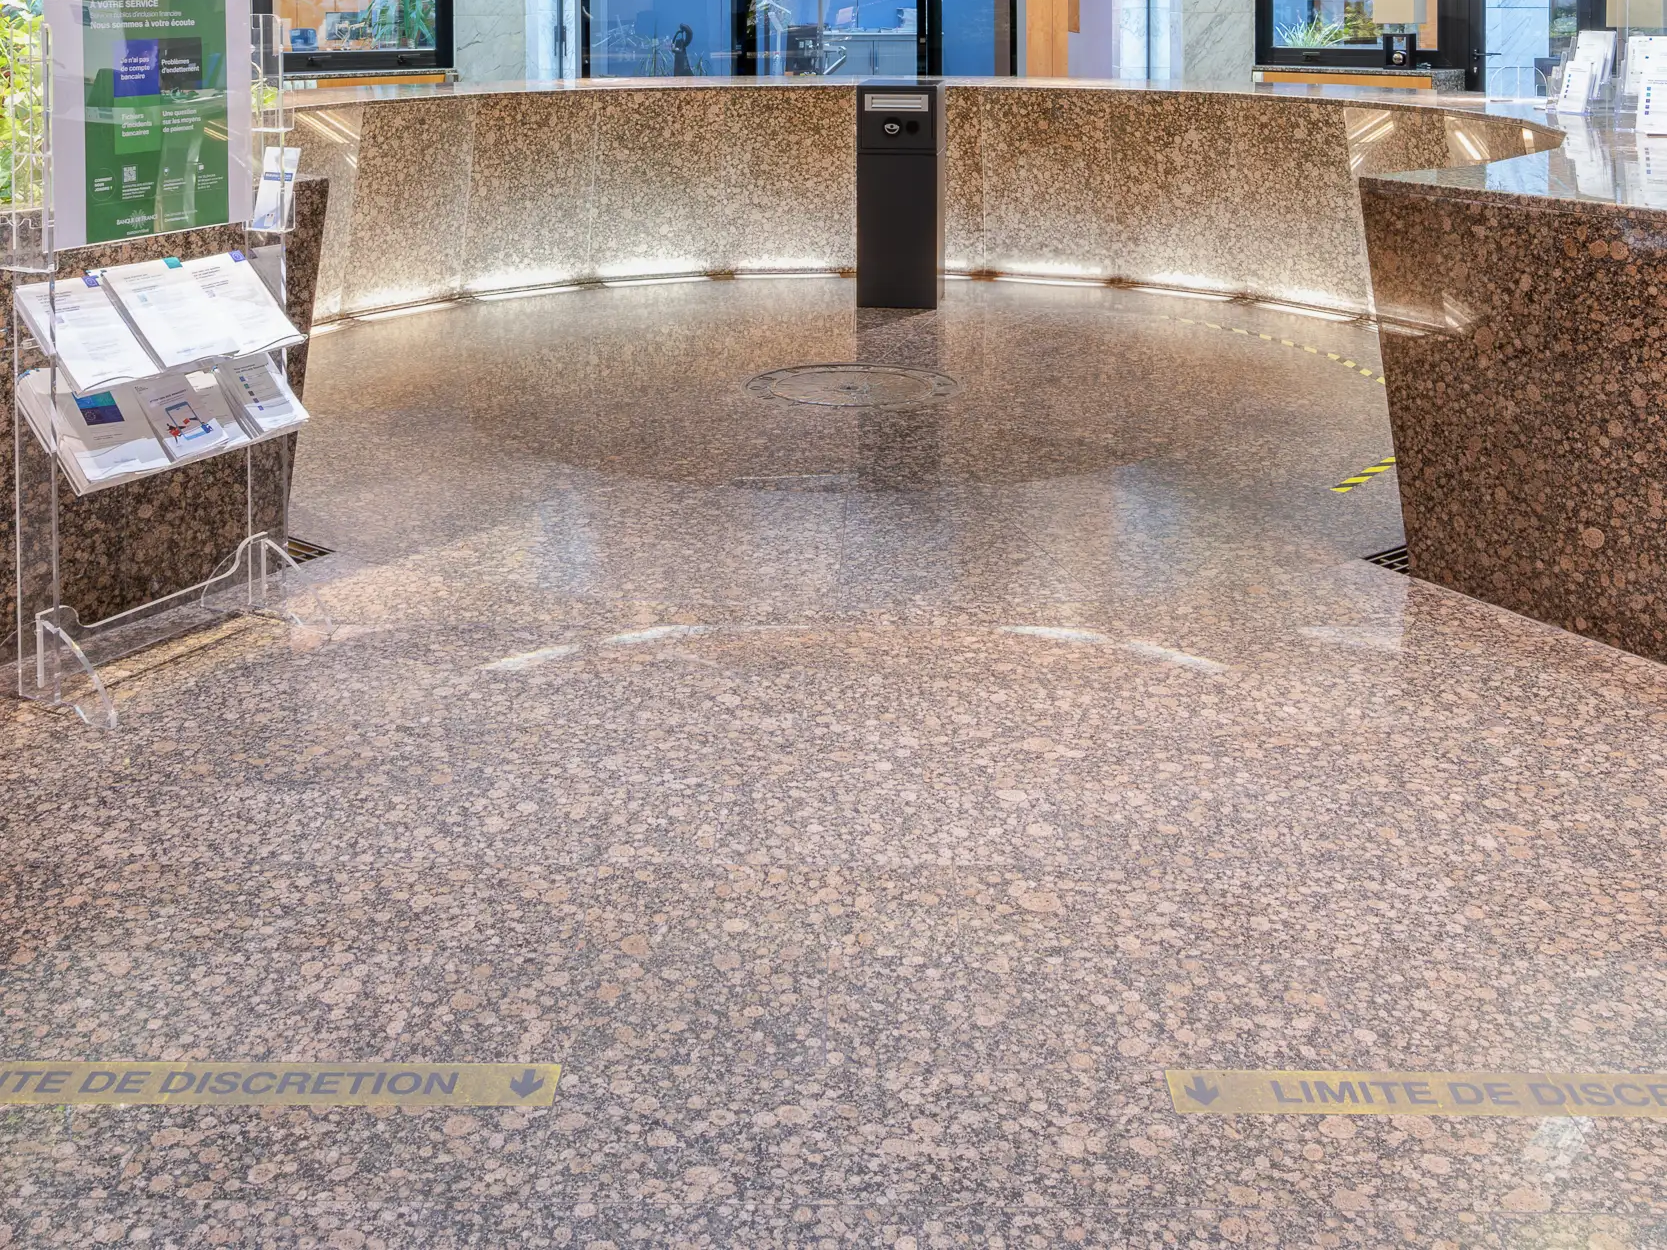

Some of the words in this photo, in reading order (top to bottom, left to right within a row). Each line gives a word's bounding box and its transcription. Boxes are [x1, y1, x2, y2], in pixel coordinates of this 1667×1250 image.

[98, 0, 124, 9] VOTRE
[125, 0, 159, 8] SERVICE
[90, 22, 111, 30] Nous
[111, 20, 143, 29] sommes
[144, 19, 150, 28] à
[151, 19, 170, 28] votre
[170, 18, 196, 27] écoute
[161, 58, 190, 66] Problèmes
[129, 64, 151, 73] compte
[120, 73, 146, 81] bancaire
[78, 1071, 151, 1094] DE
[158, 1071, 460, 1095] DISCRETION
[1270, 1080, 1438, 1105] LIMITE
[1447, 1082, 1521, 1105] DE
